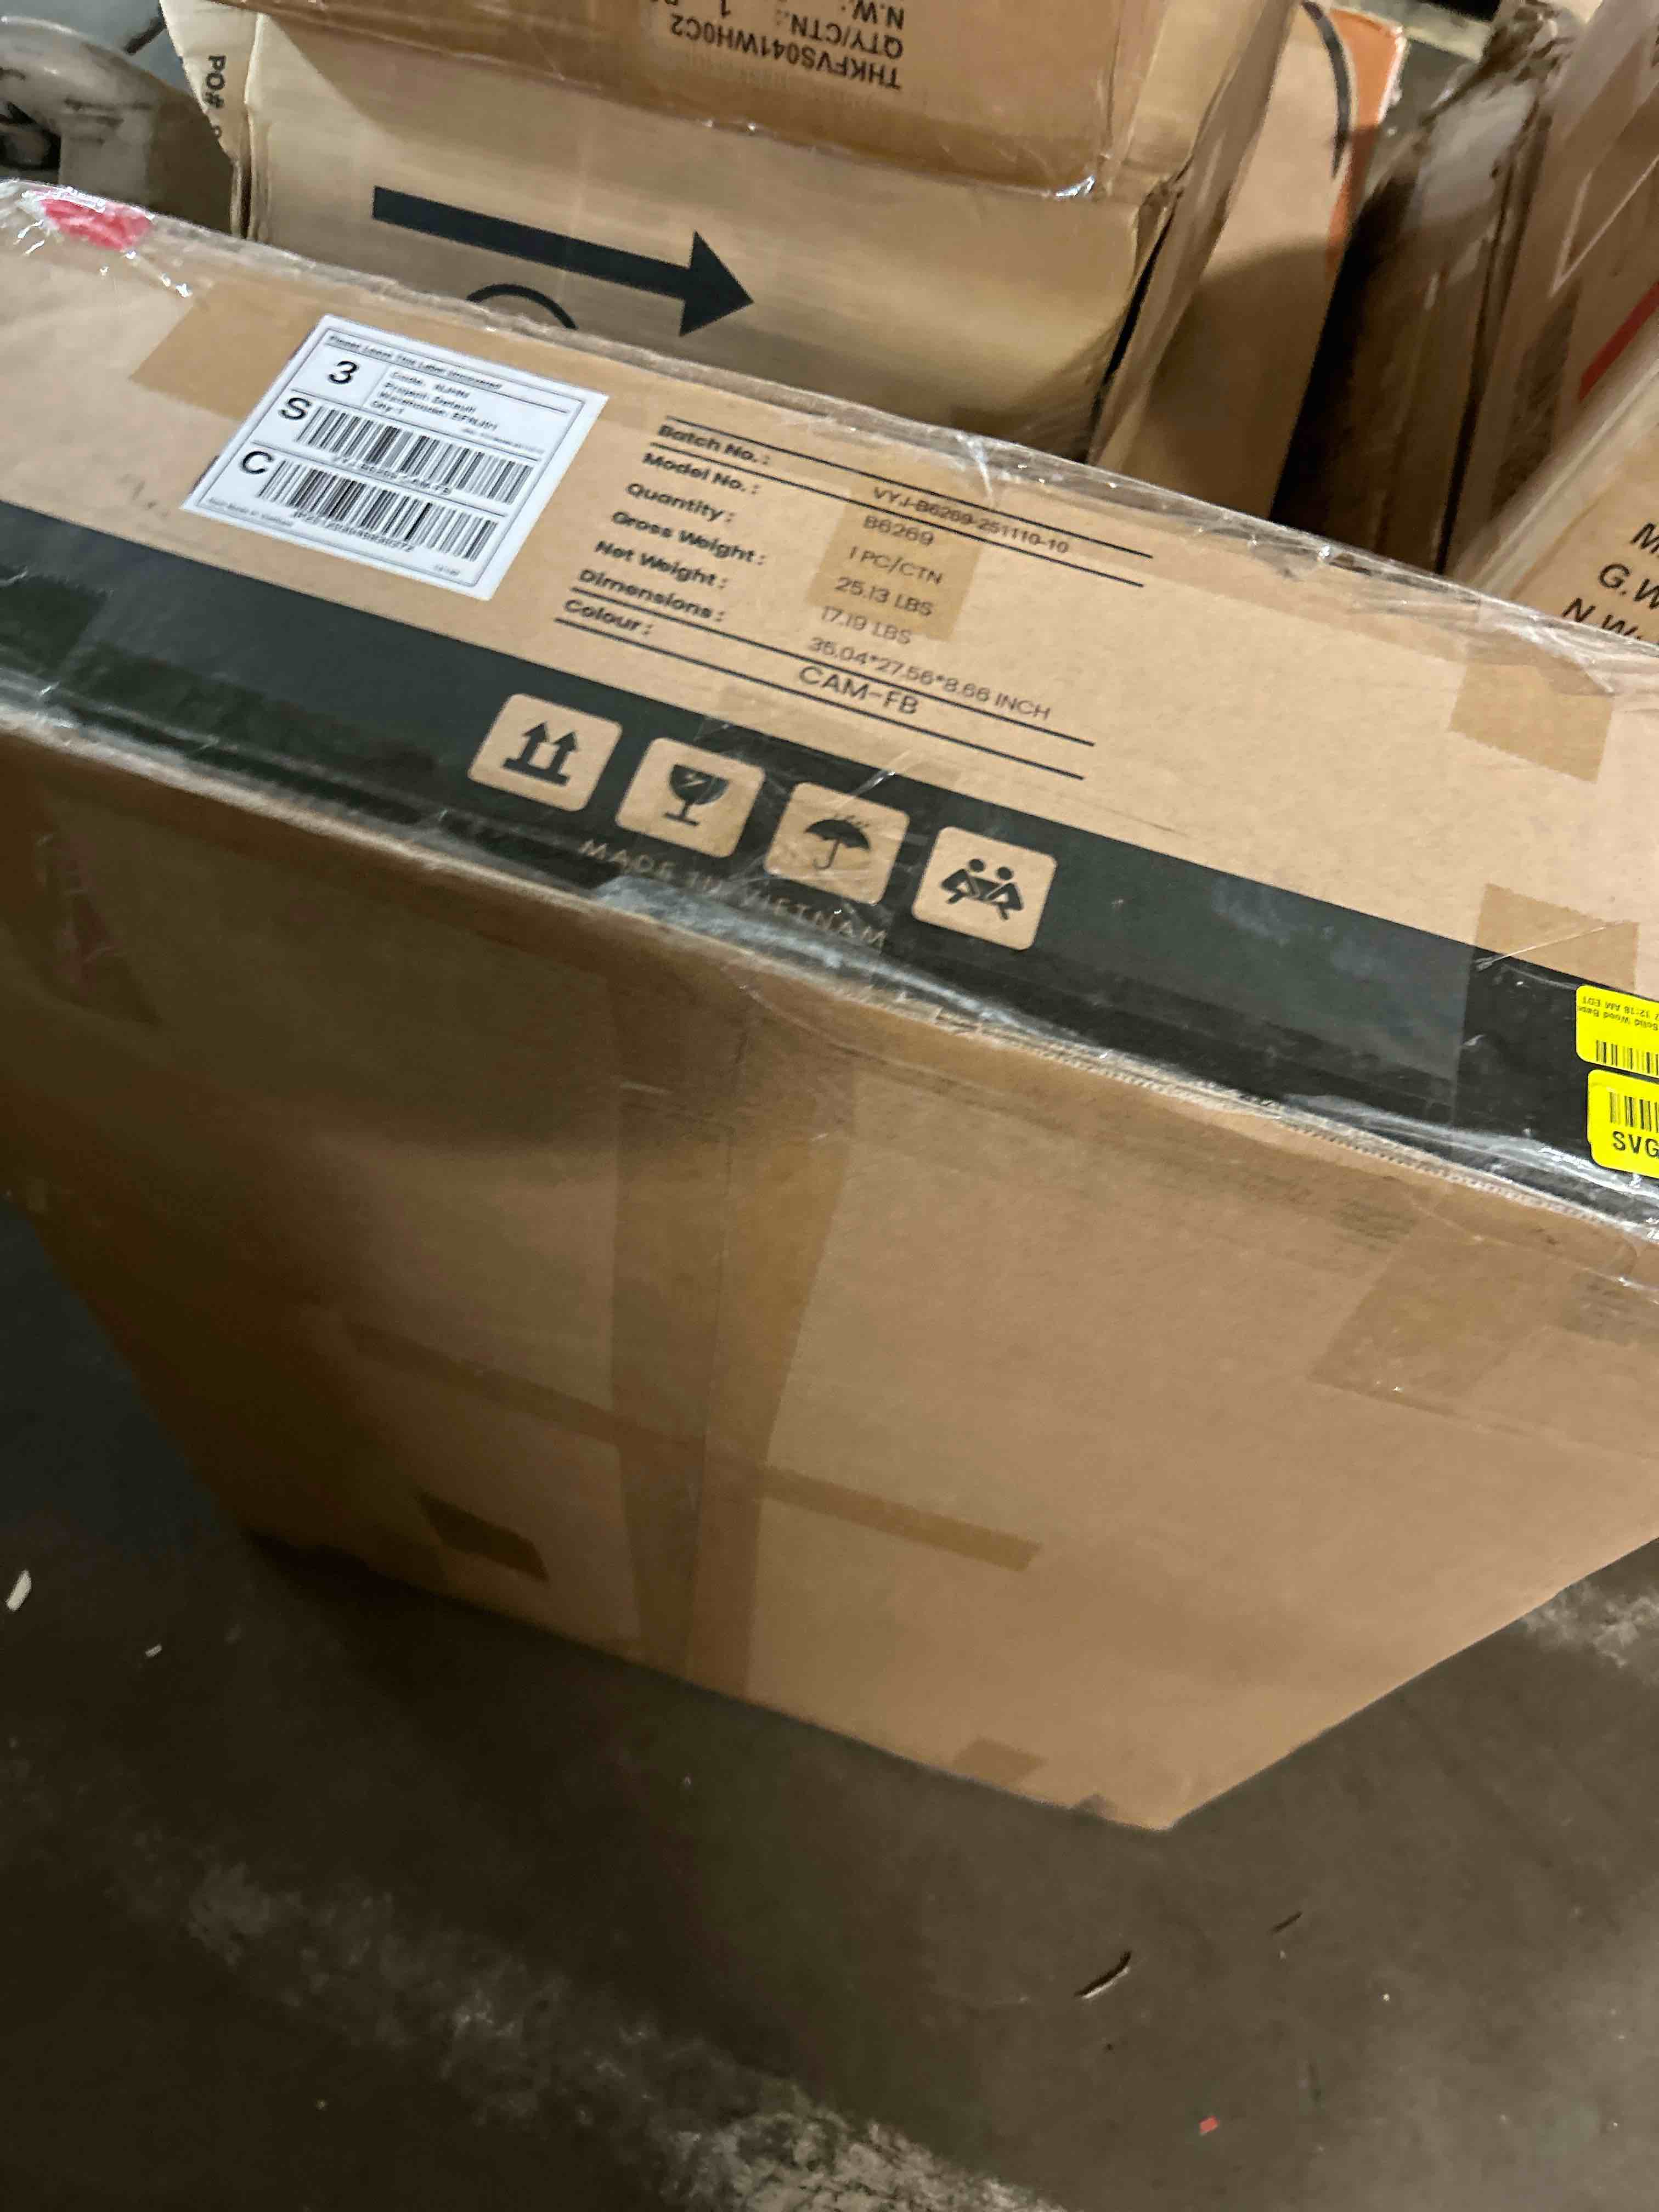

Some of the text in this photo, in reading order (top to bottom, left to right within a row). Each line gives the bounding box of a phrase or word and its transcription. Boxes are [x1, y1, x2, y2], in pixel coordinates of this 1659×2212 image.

[329, 360, 359, 385] 3
[278, 397, 312, 420] S
[658, 424, 721, 452] Batch
[241, 451, 274, 475] C
[642, 453, 712, 480] Model
[612, 510, 673, 538] Gross
[834, 576, 891, 605] 25.13
[894, 592, 934, 618] LBS
[860, 549, 944, 585] PC/CTN
[595, 540, 634, 562] Net
[871, 620, 913, 646] LBS
[799, 665, 920, 715] CAM-FB
[994, 692, 1052, 720] INCH
[578, 838, 678, 881] MADE
[688, 870, 724, 897] IN
